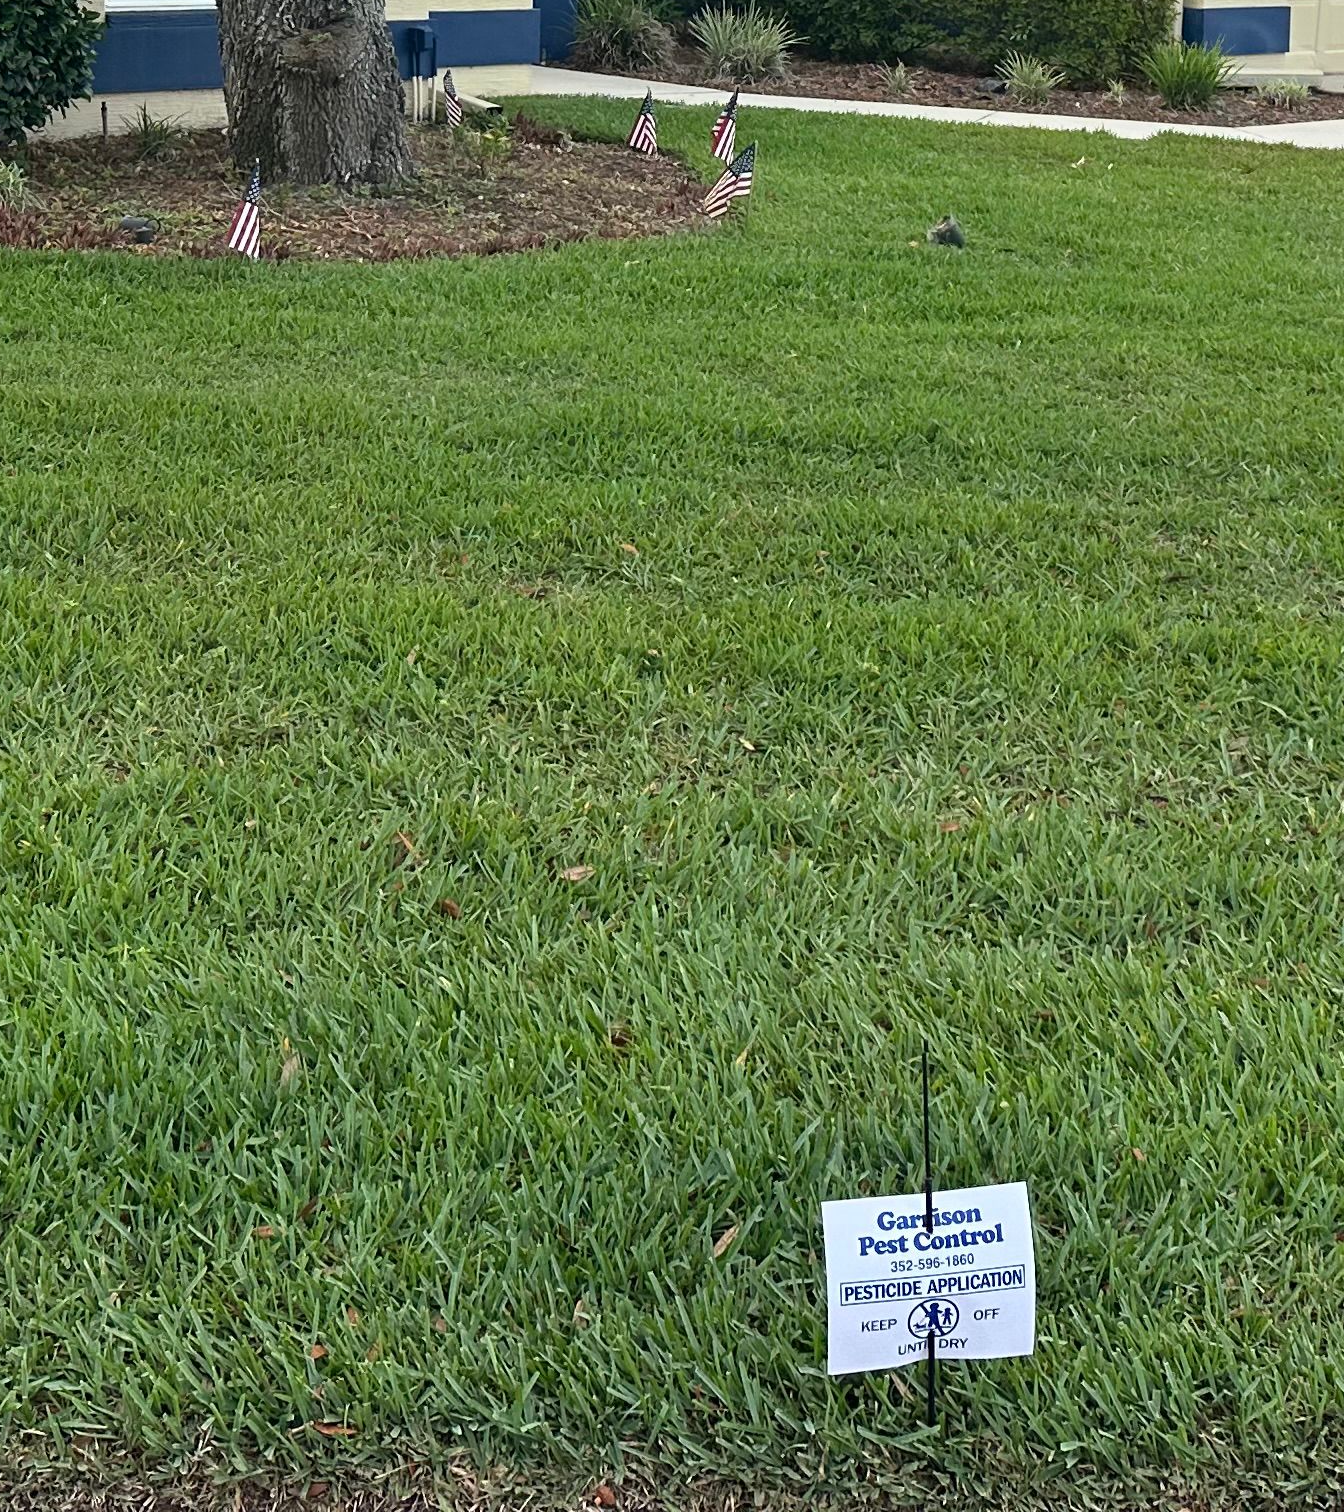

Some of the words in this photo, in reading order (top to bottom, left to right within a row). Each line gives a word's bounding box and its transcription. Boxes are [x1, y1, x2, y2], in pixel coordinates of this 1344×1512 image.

[858, 1237, 909, 1256] Pest
[913, 1223, 1004, 1251] Control
[890, 1253, 975, 1273] 352-596-1860
[844, 1280, 923, 1302] PESTICIDE
[927, 1269, 1023, 1294] APPLICATION
[861, 1318, 898, 1332] KEEP
[973, 1308, 1000, 1322] OFF
[898, 1339, 934, 1356] UNTI
[939, 1338, 969, 1349] DRY
